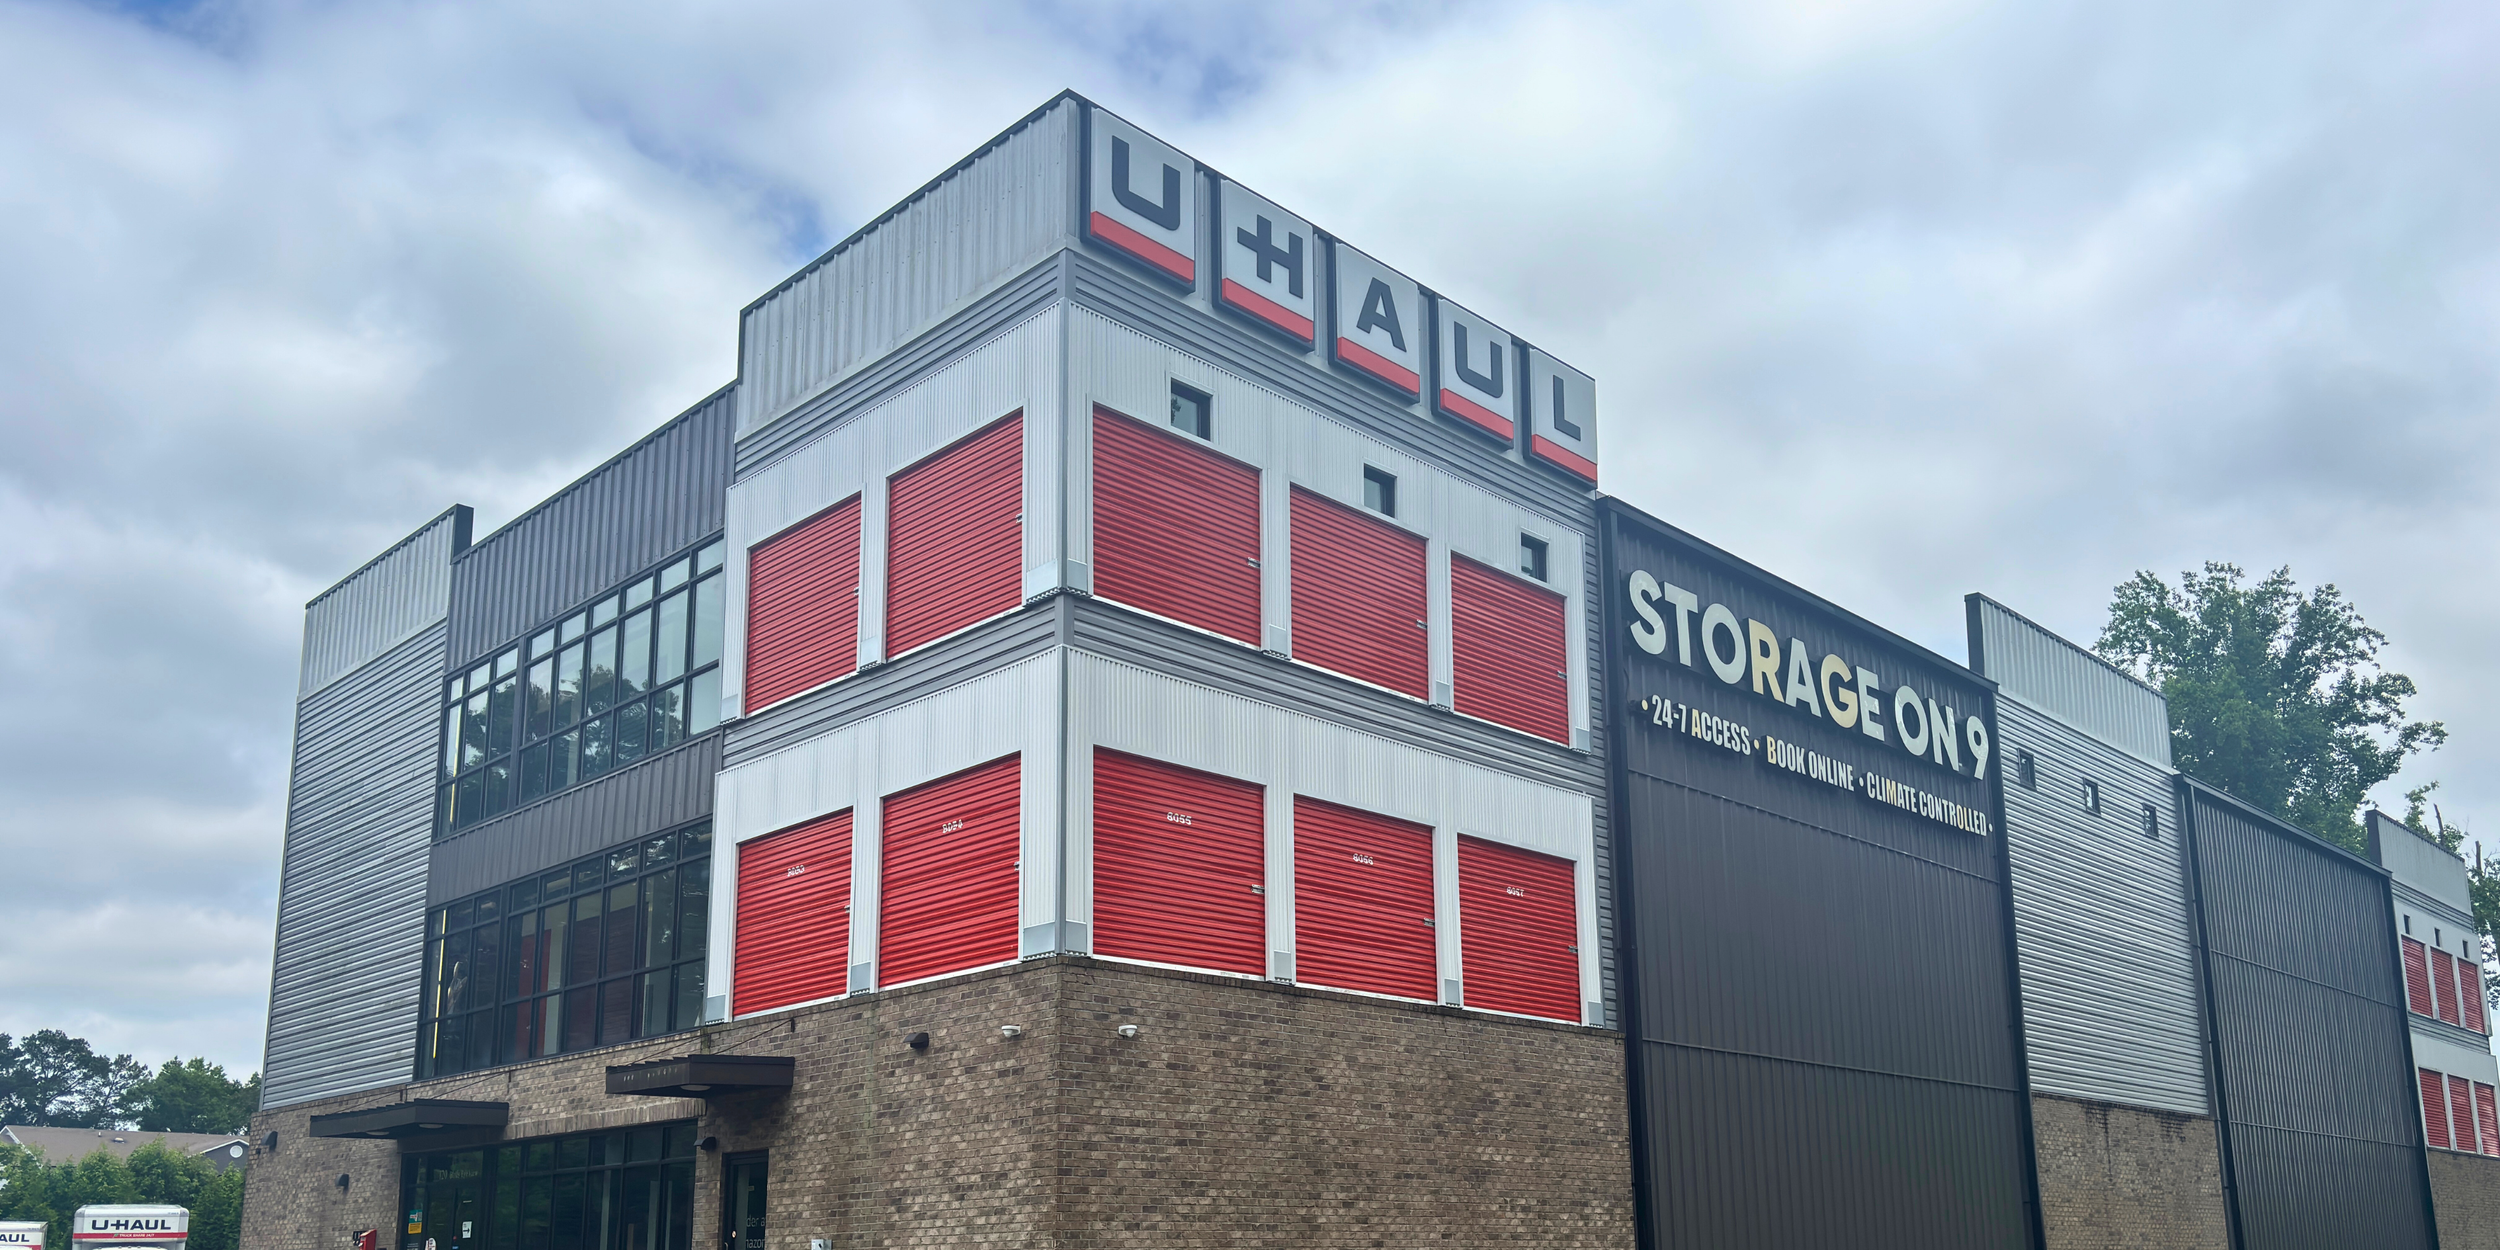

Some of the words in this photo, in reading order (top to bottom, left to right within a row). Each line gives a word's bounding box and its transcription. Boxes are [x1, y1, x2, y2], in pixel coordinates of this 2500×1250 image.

[1628, 569, 1885, 742] STORAGE
[1894, 685, 1960, 772] ON
[1966, 715, 1990, 781] 9
[1652, 694, 1687, 734] 24-7
[1691, 708, 1751, 756] ACCESS
[1766, 735, 1806, 775] BOOK
[1808, 750, 1855, 792] ONLINE
[1866, 771, 1918, 814] CLIMATE
[1919, 790, 1987, 837] CONTROLLED
[1166, 811, 1192, 825] 8055
[942, 818, 964, 834] 8054
[1352, 853, 1374, 866] 8056
[91, 1219, 172, 1231] U-HAUL
